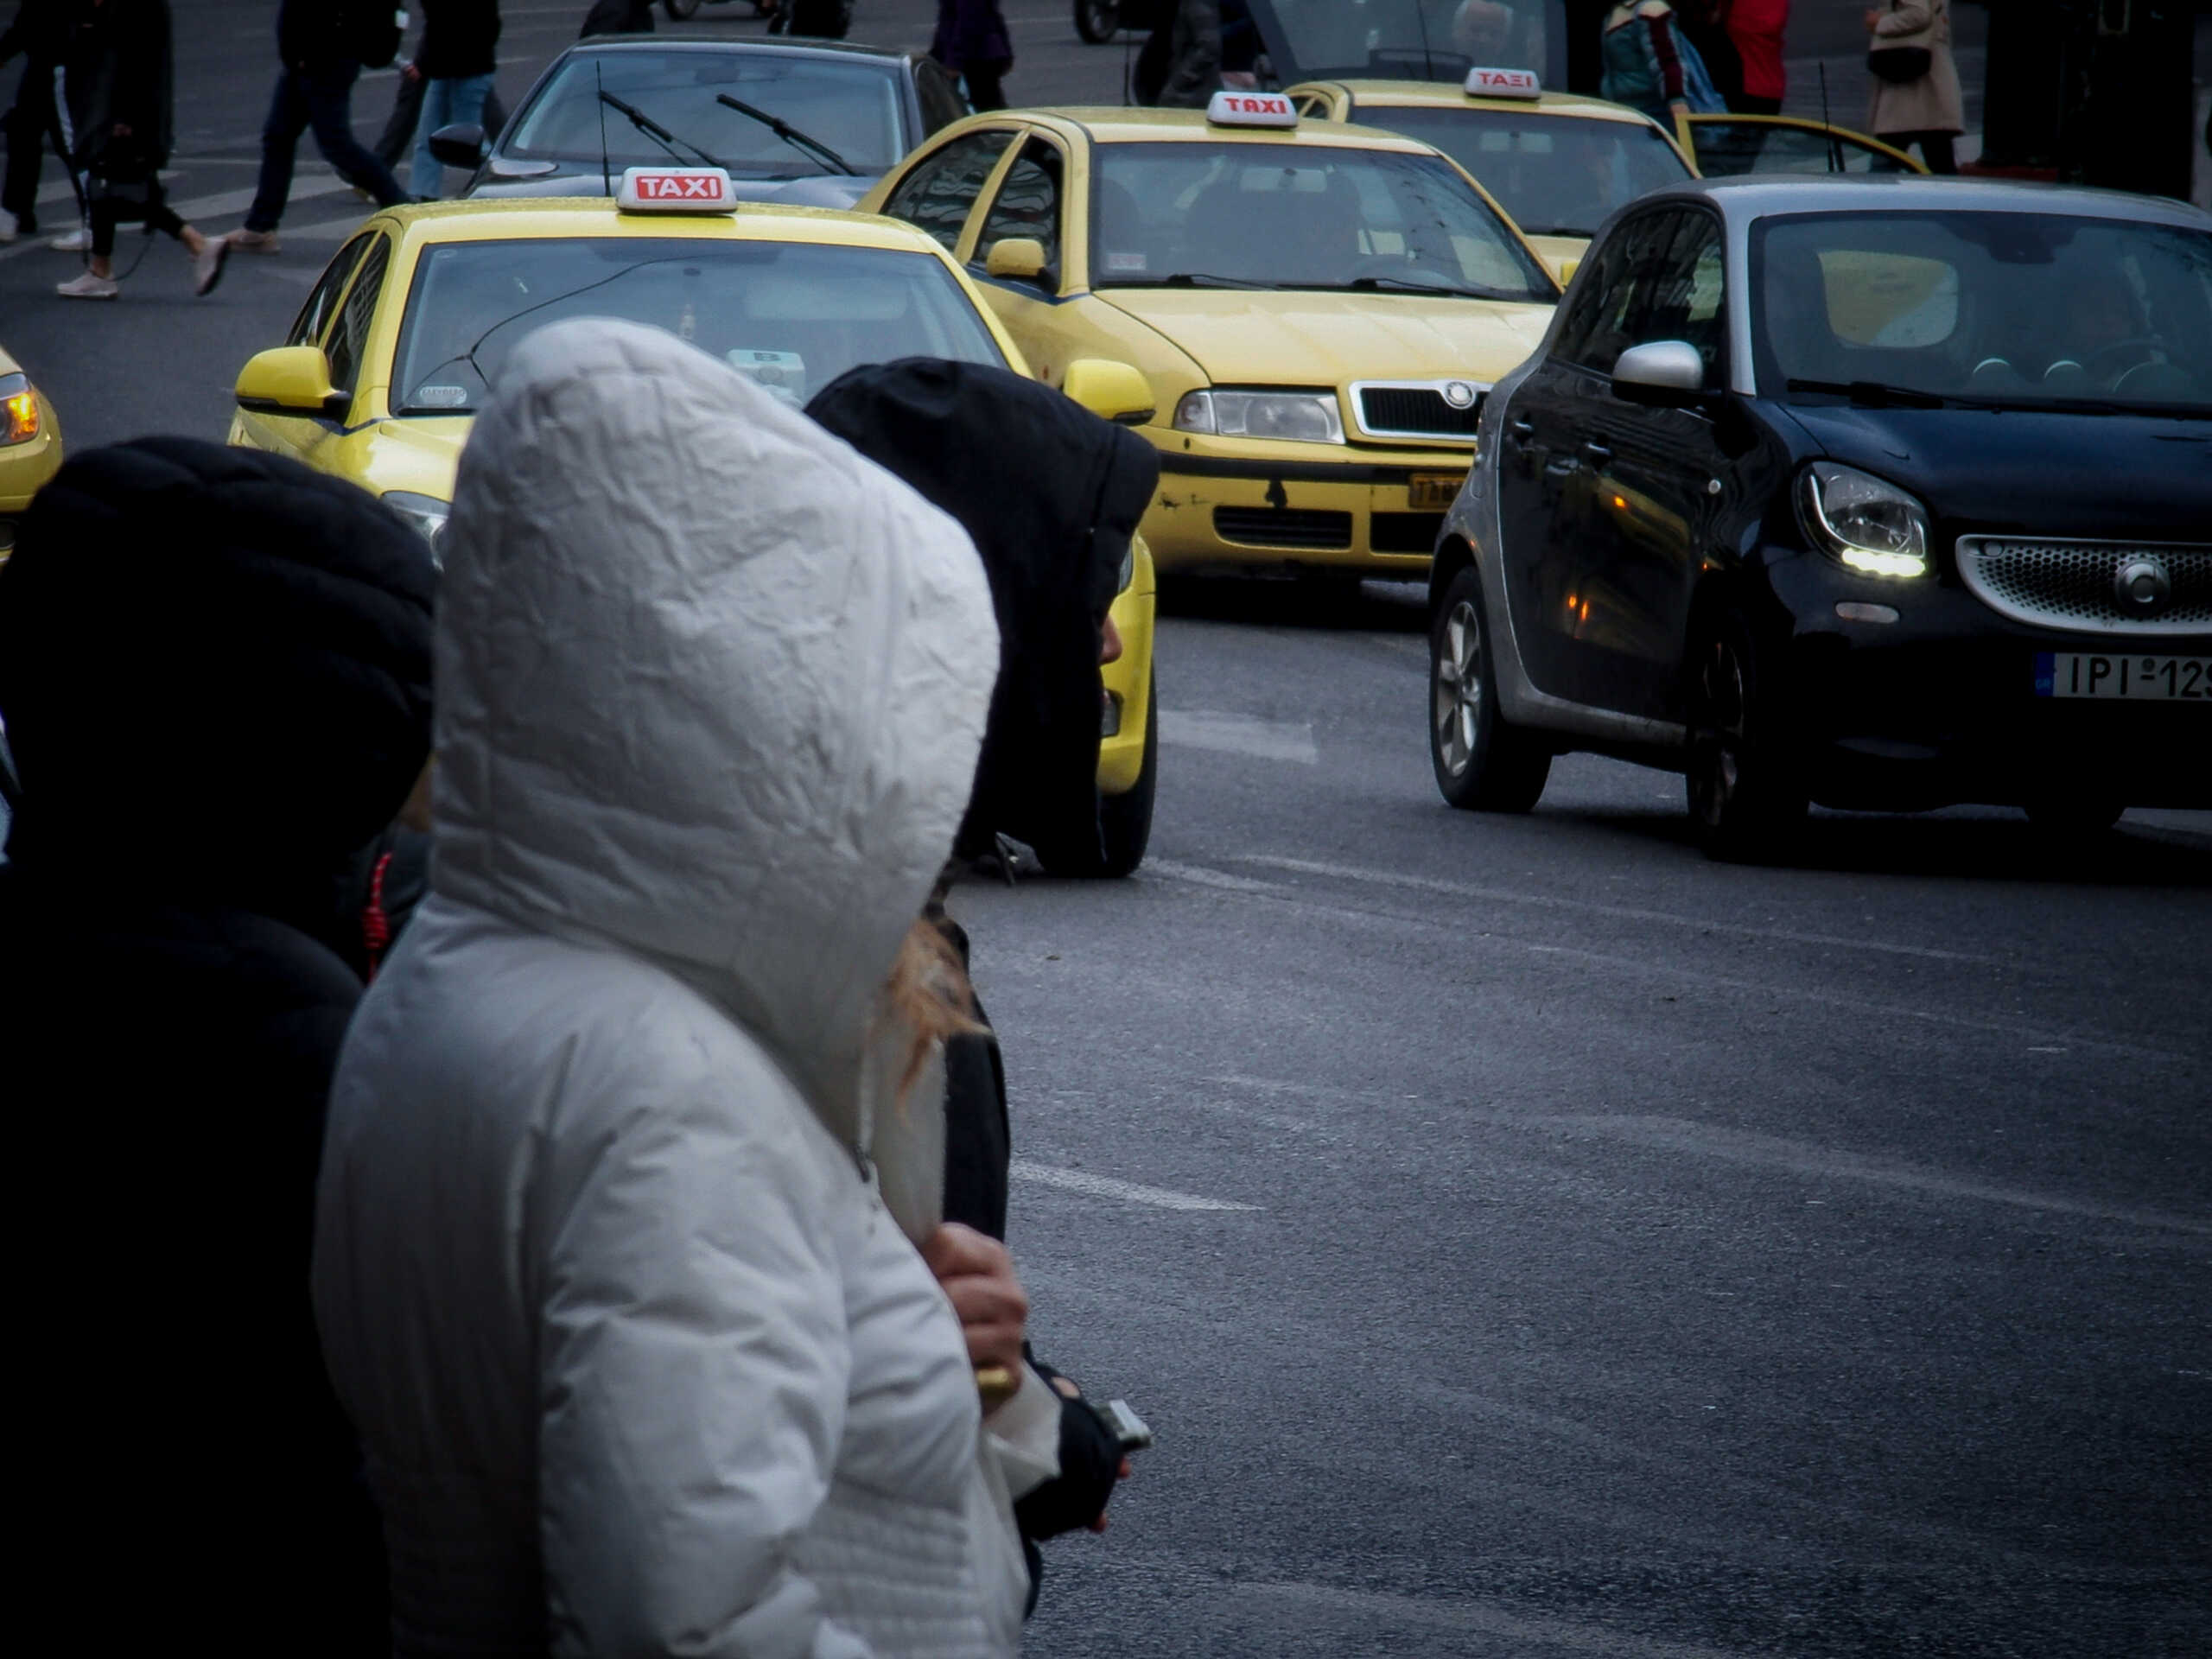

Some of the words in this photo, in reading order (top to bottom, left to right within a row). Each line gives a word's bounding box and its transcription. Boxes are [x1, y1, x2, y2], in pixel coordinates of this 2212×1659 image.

[1224, 98, 1287, 114] TAXI
[640, 177, 718, 197] TAXI
[2072, 657, 2212, 697] IPI-12
